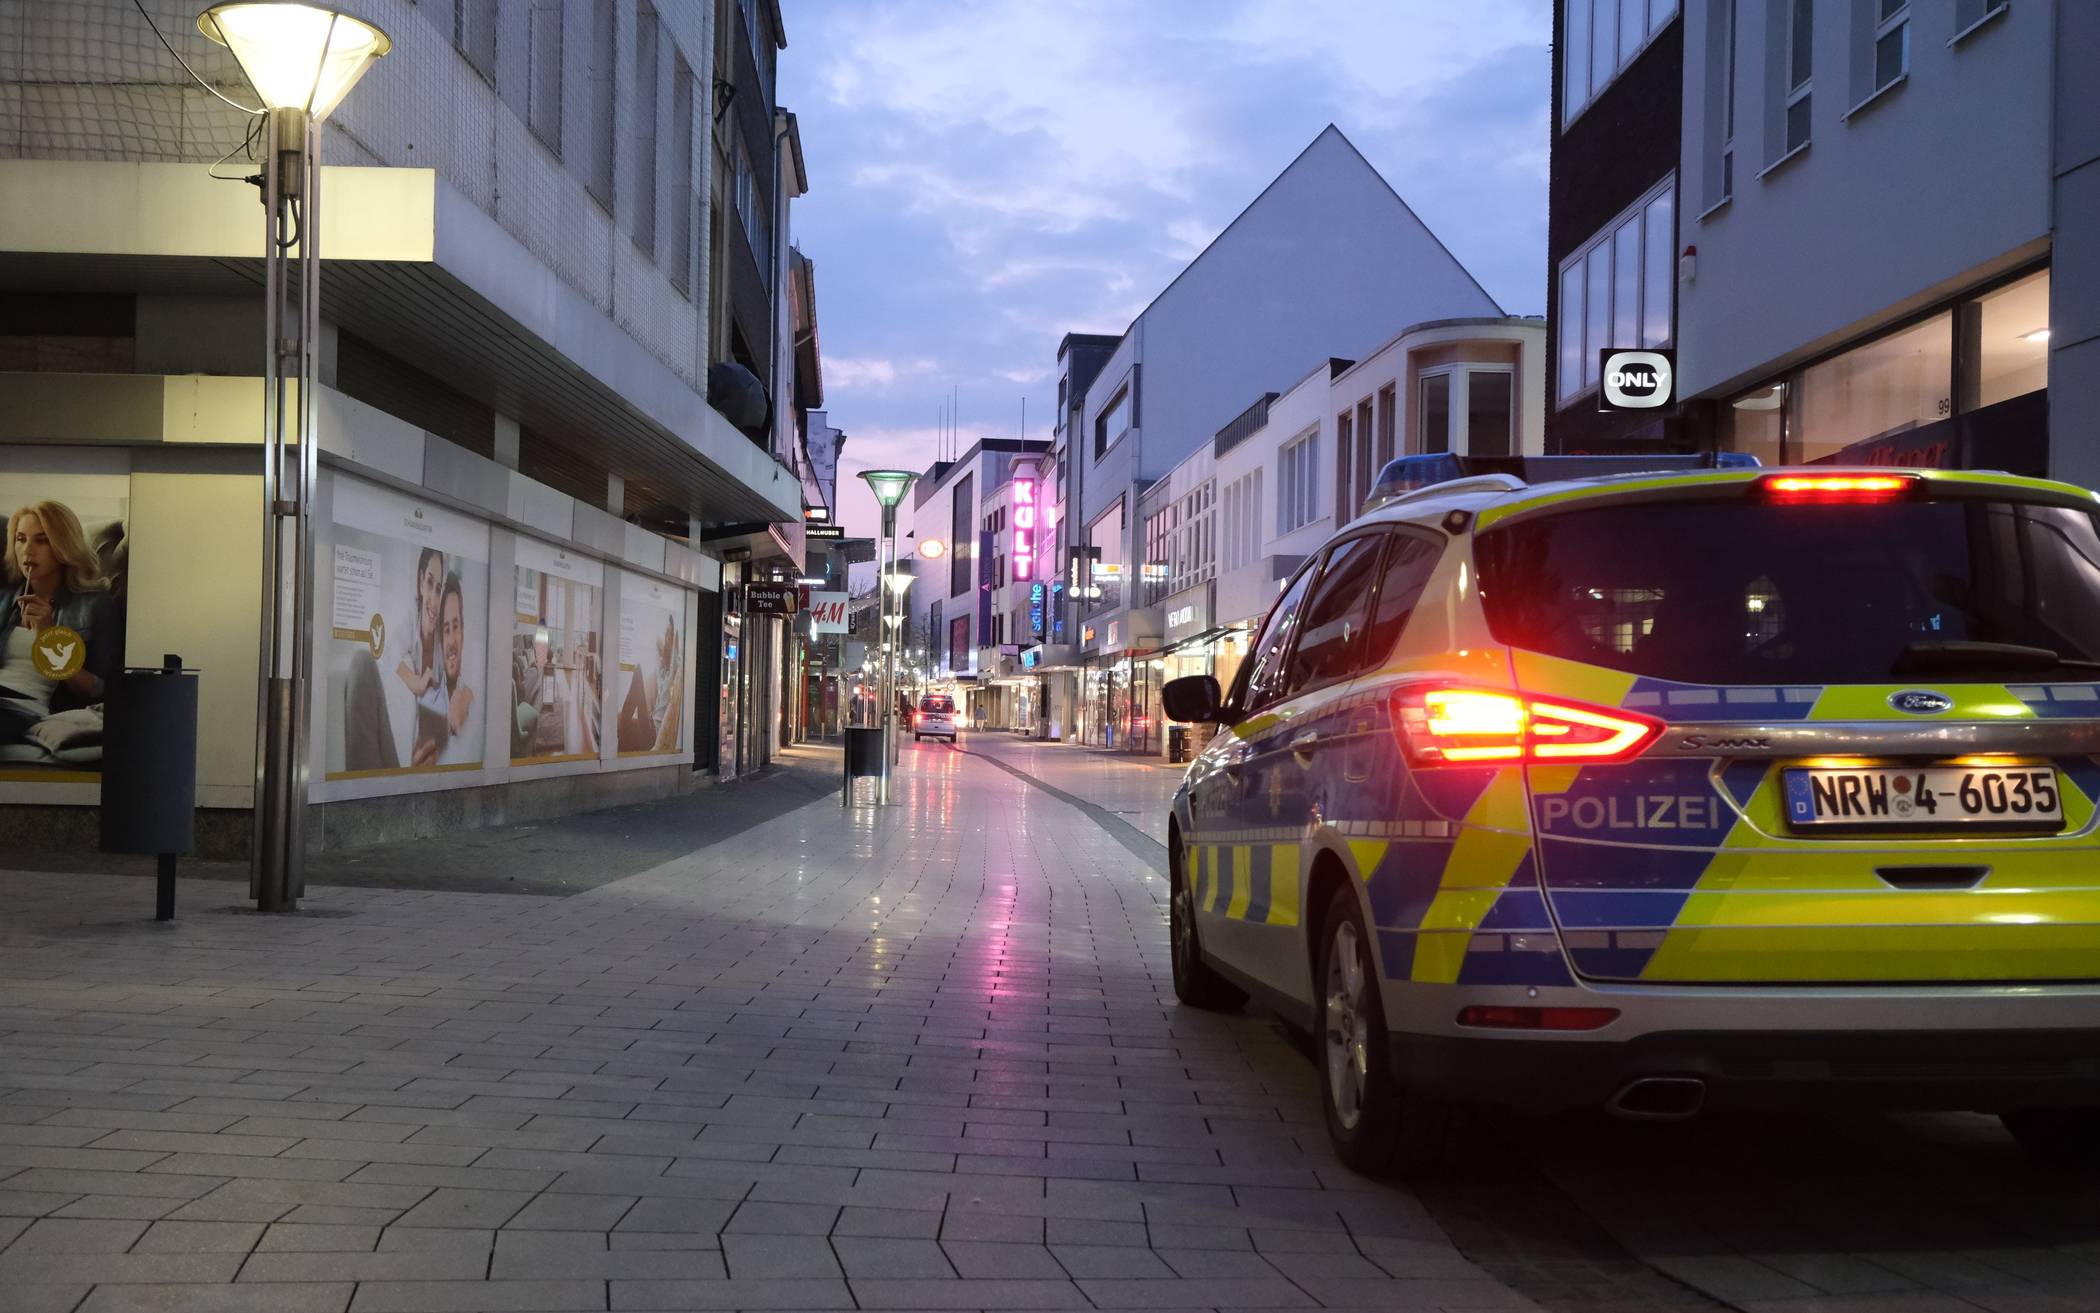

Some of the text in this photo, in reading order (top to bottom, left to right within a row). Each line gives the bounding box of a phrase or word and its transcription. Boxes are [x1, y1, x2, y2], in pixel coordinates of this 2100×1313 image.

[1607, 372, 1667, 388] ONLY
[1938, 398, 1950, 414] 99
[1013, 480, 1034, 579] KULT
[751, 591, 780, 599] Bubble
[758, 600, 773, 608] Tee
[810, 602, 845, 625] H&M
[1903, 695, 1942, 708] Ford
[1811, 773, 2057, 816] NRW 4-6035
[1542, 795, 1720, 830] POLIZEI
[1796, 801, 1807, 814] D
